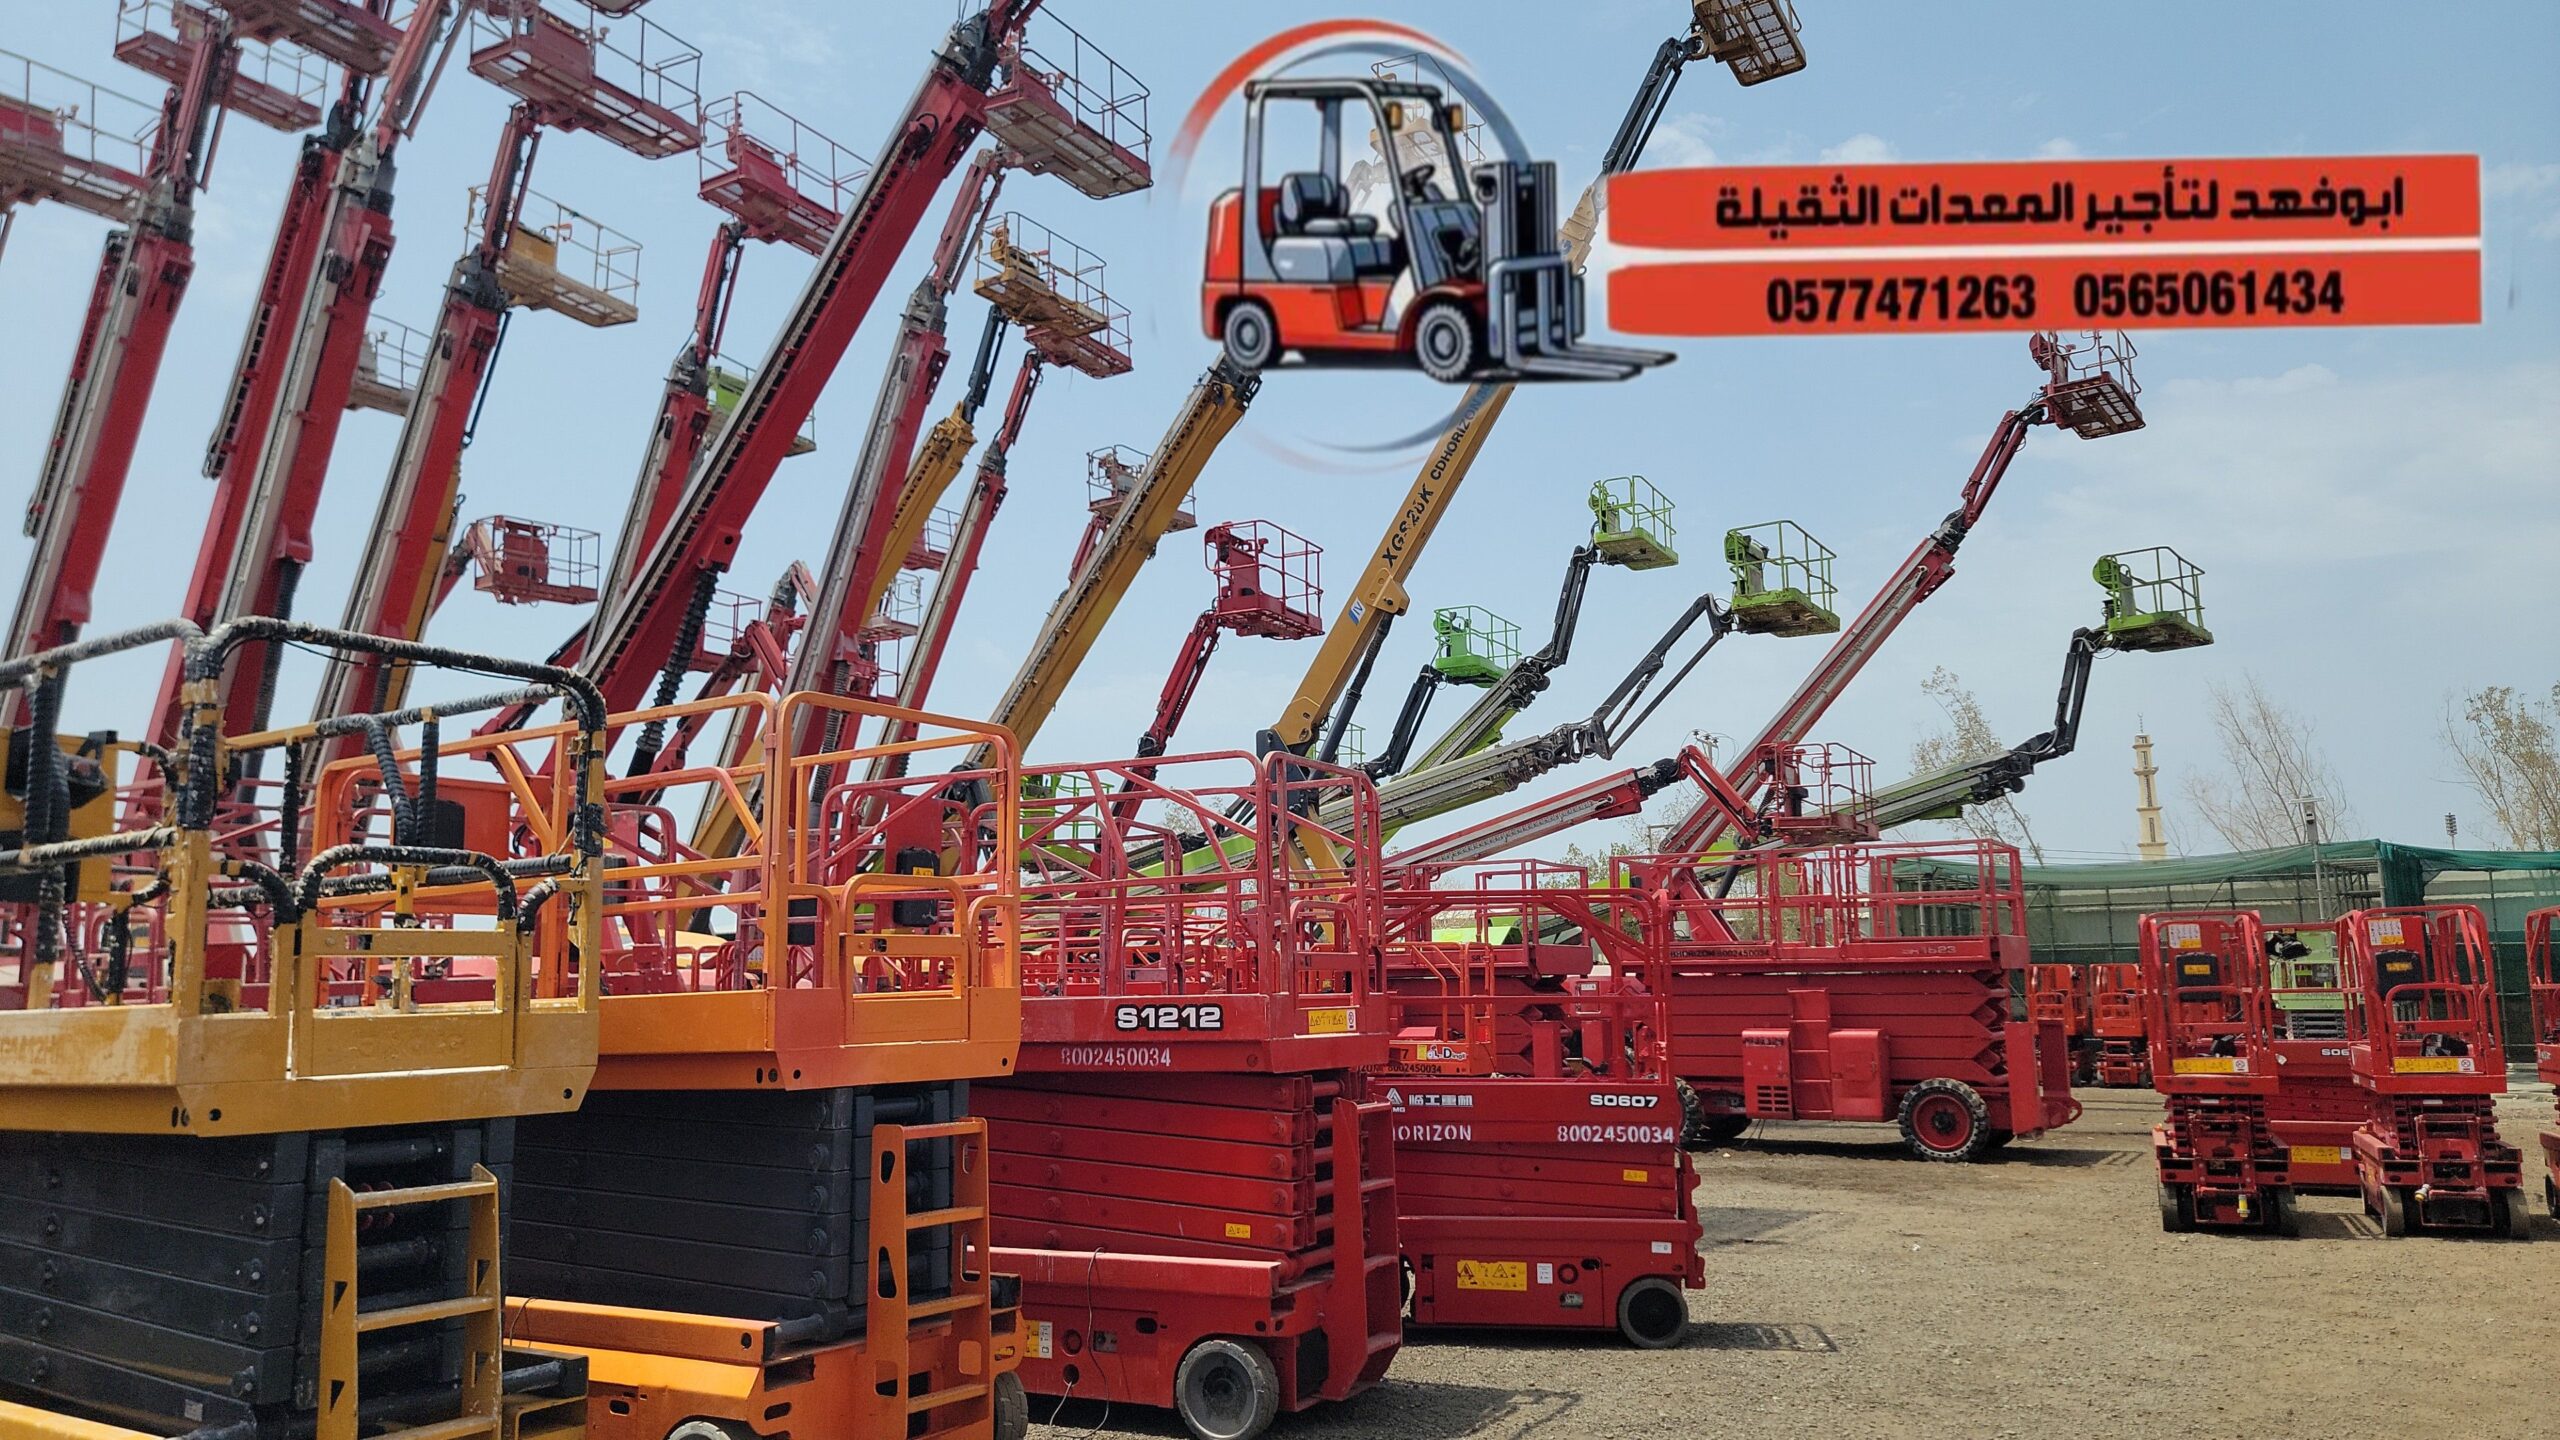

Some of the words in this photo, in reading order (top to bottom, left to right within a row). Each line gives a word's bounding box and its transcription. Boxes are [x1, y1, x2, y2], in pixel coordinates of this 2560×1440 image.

[1116, 1006, 1222, 1029] S1212
[1061, 1047, 1172, 1067] 8002450034
[1557, 1125, 1674, 1143] 8002450034
